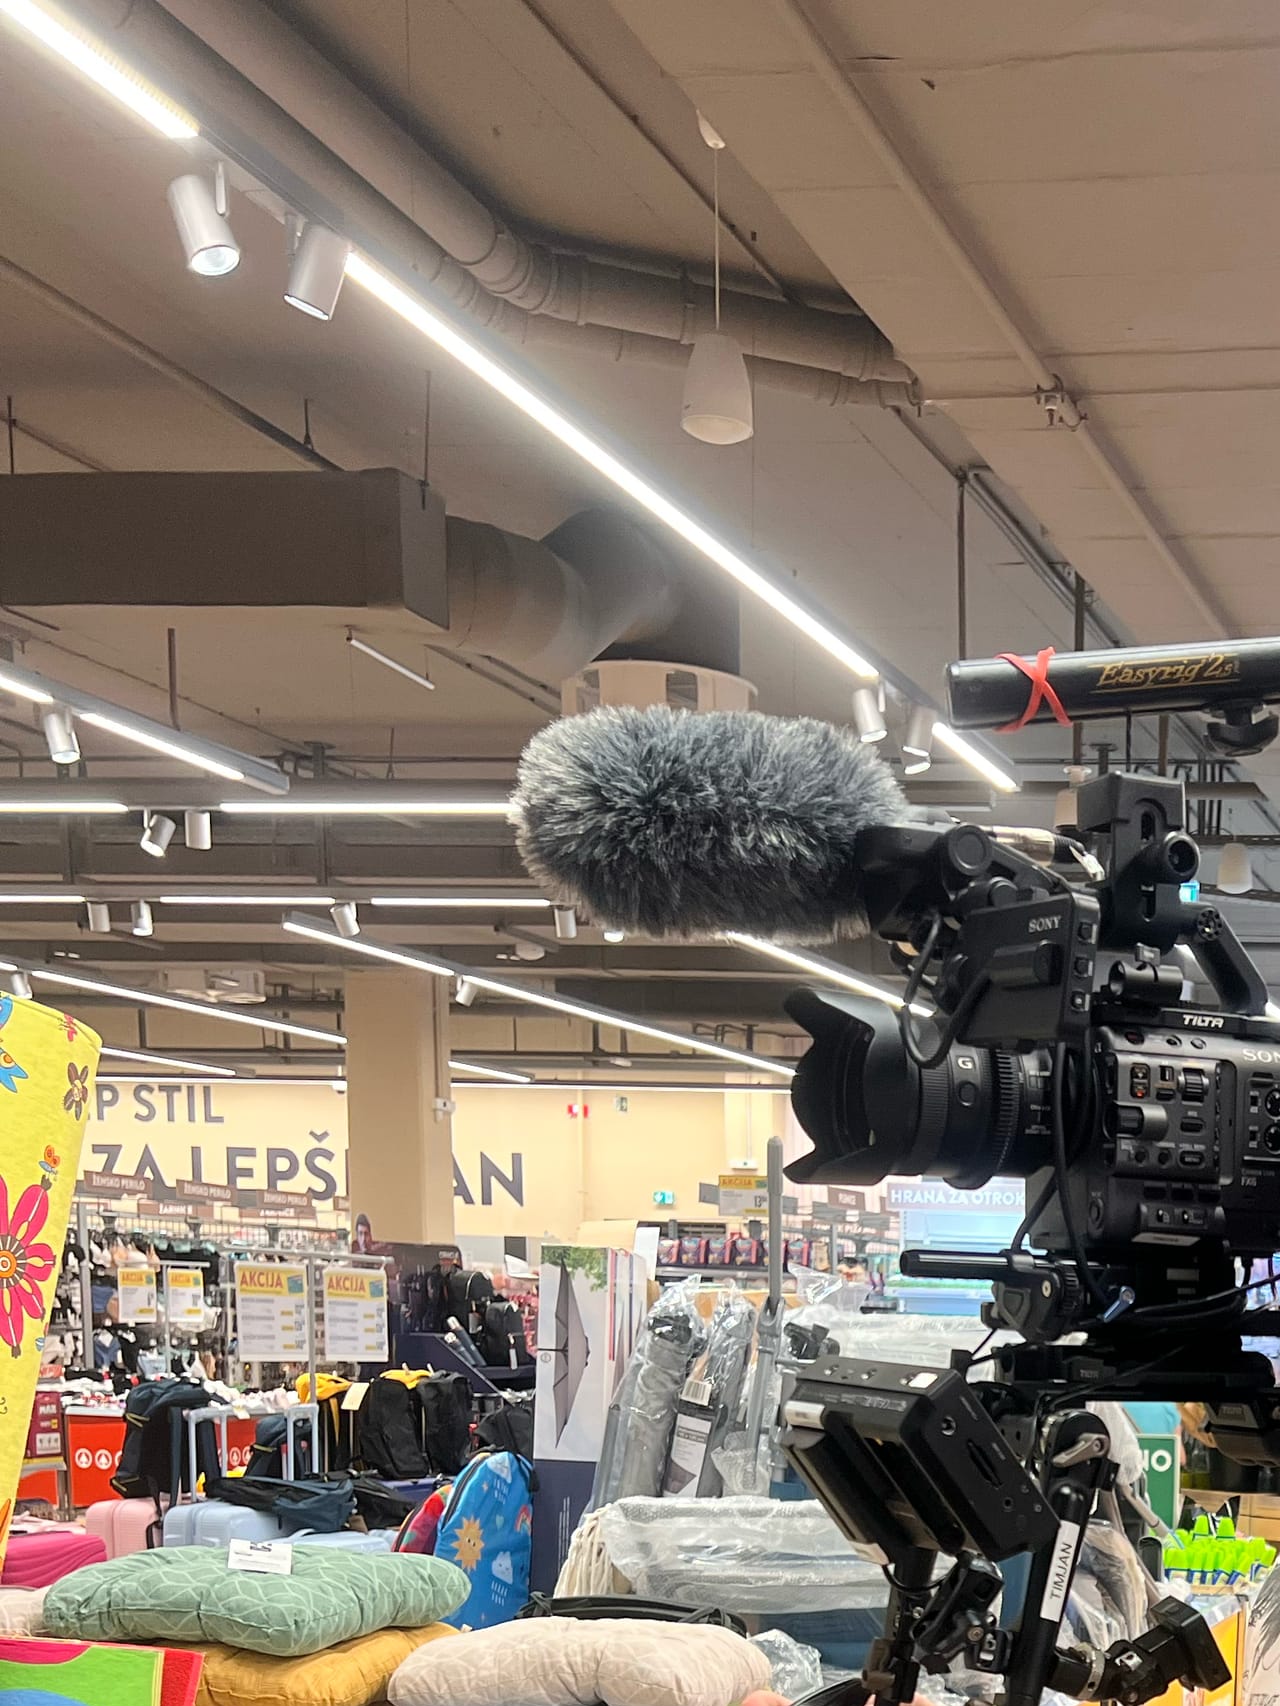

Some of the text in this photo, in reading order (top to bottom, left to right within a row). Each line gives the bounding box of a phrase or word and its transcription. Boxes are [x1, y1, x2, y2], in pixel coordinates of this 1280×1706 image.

[1096, 657, 1206, 688] Easyrig
[1028, 915, 1061, 934] SONY
[1183, 1014, 1224, 1029] TILTA
[88, 1084, 224, 1123] P STIL
[191, 1130, 350, 1201] LEPŠ
[891, 1188, 946, 1205] HRANA
[948, 1189, 970, 1206] ZA
[240, 1270, 284, 1290] AKCIJA
[327, 1276, 366, 1293] AKCIJA
[1050, 1542, 1074, 1600] TIMJAN
